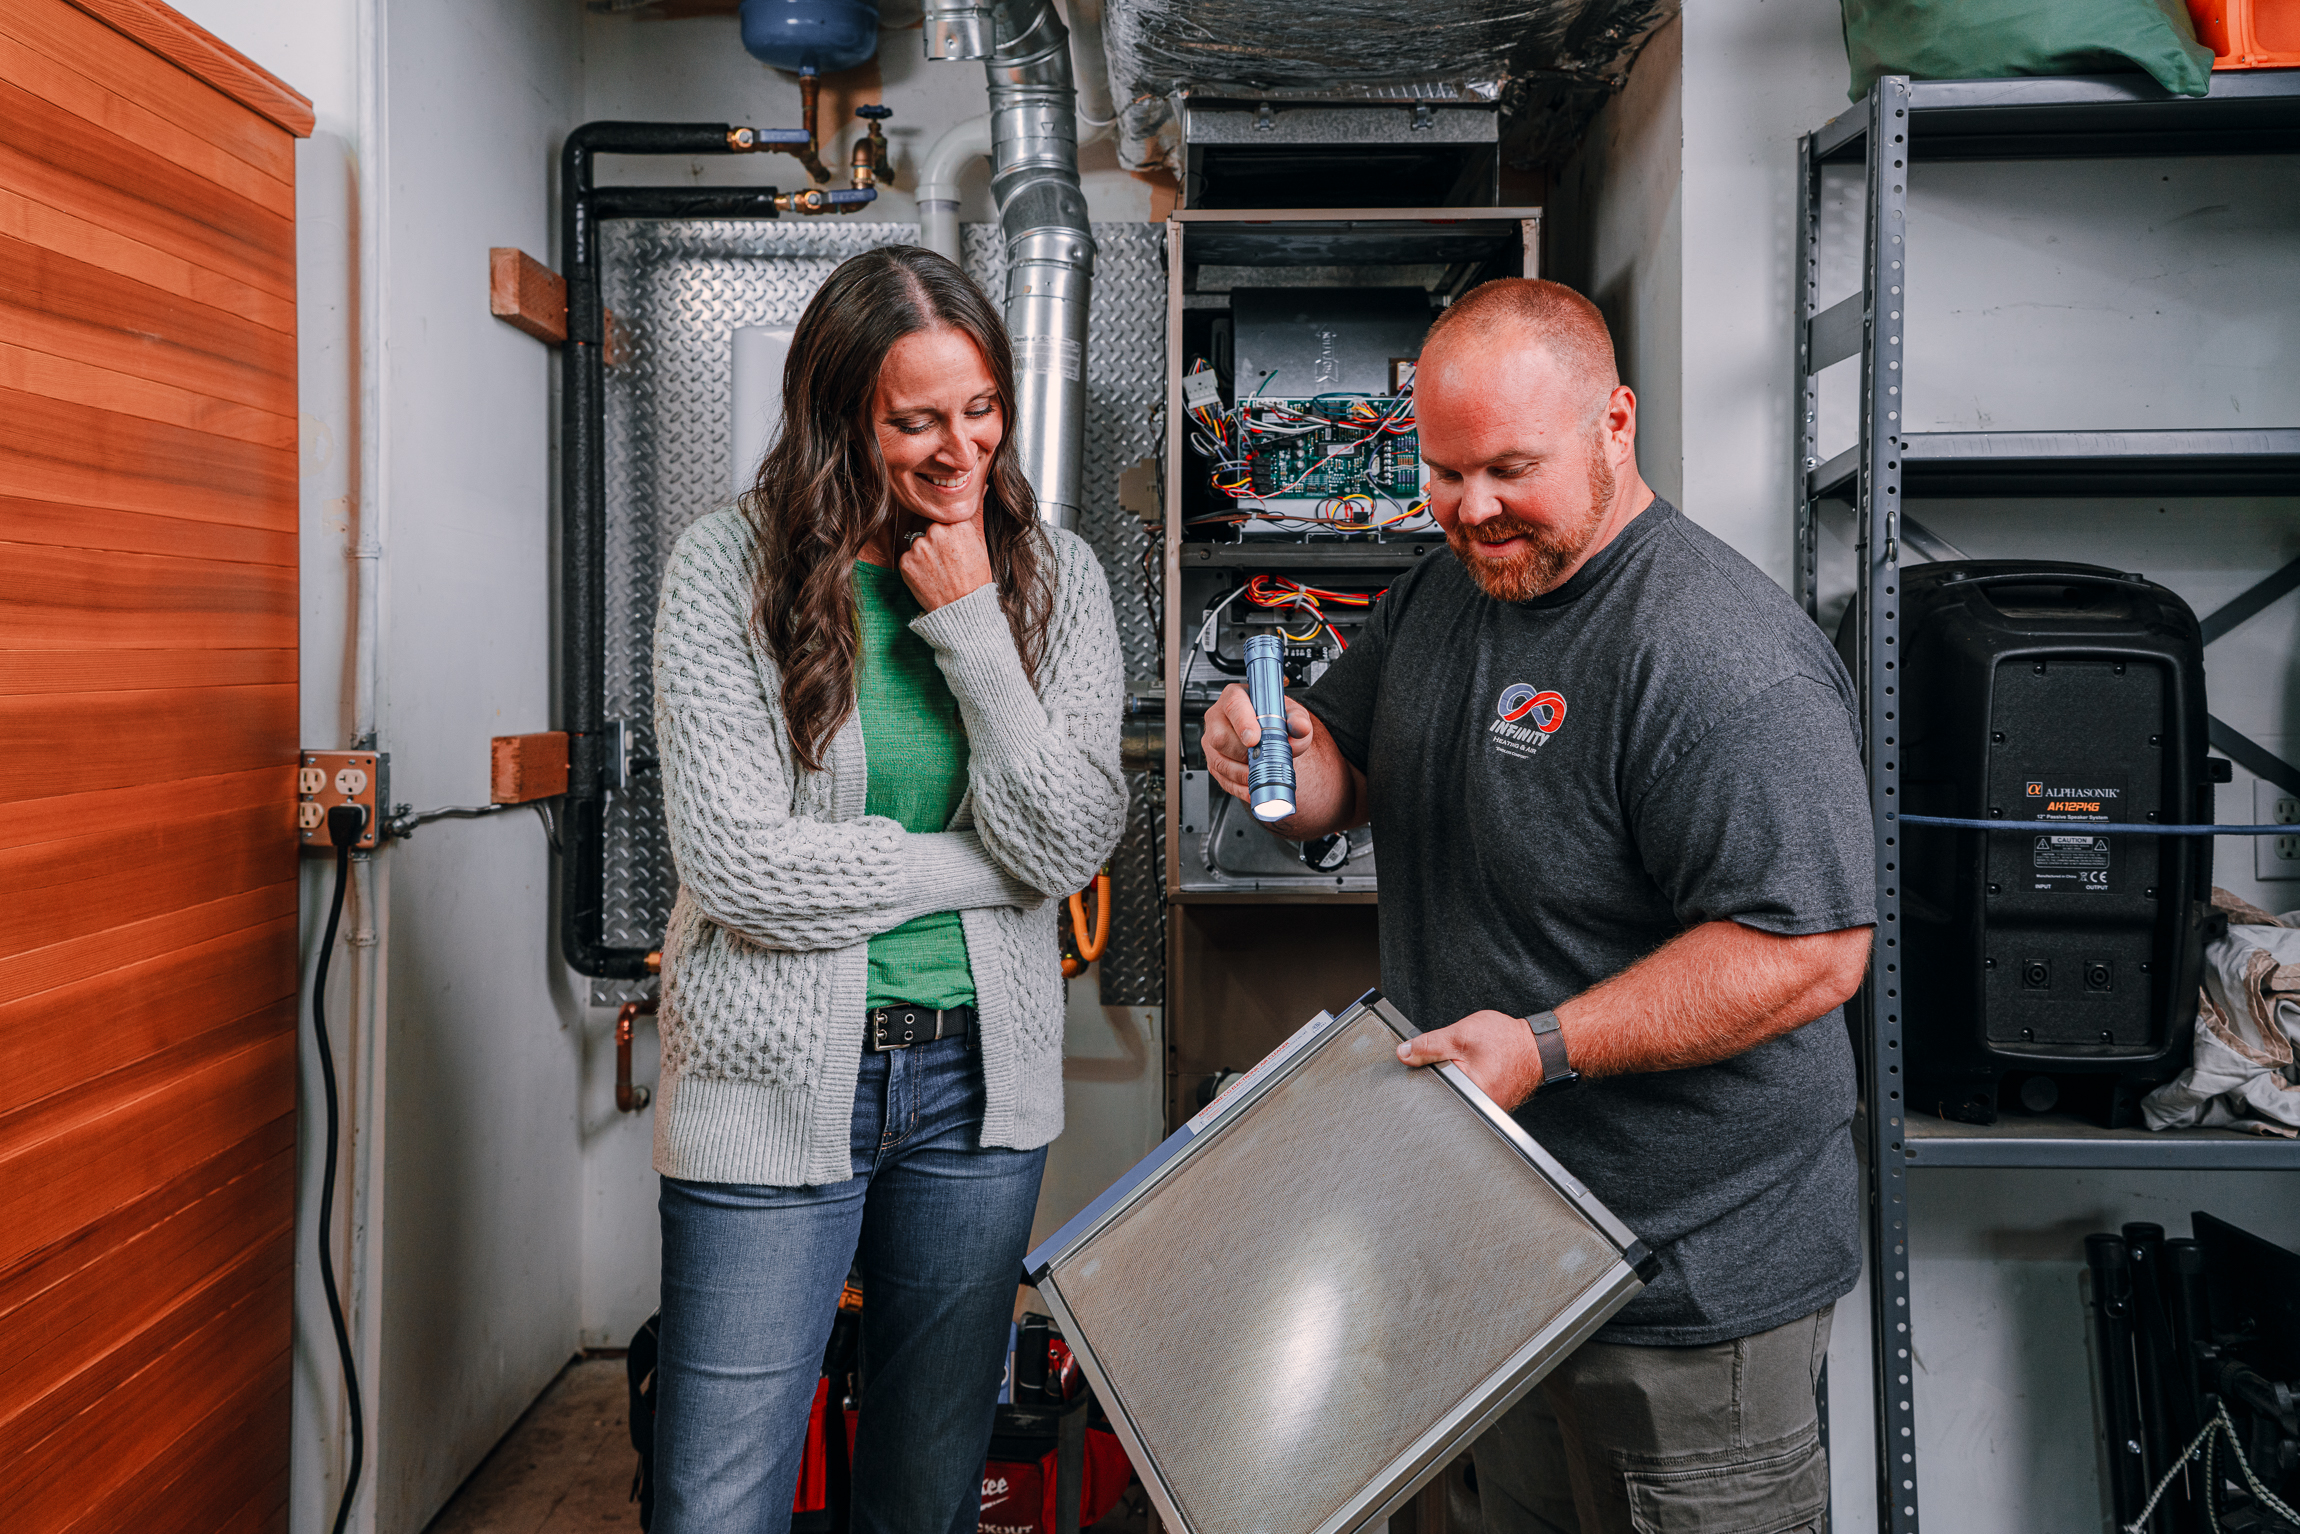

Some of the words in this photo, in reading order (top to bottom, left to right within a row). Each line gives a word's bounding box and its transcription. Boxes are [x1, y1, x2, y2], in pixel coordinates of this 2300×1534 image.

[1489, 719, 1550, 747] INFINITY
[2047, 802, 2101, 811] AK12PKG
[1267, 1042, 1290, 1060] CLEANER
